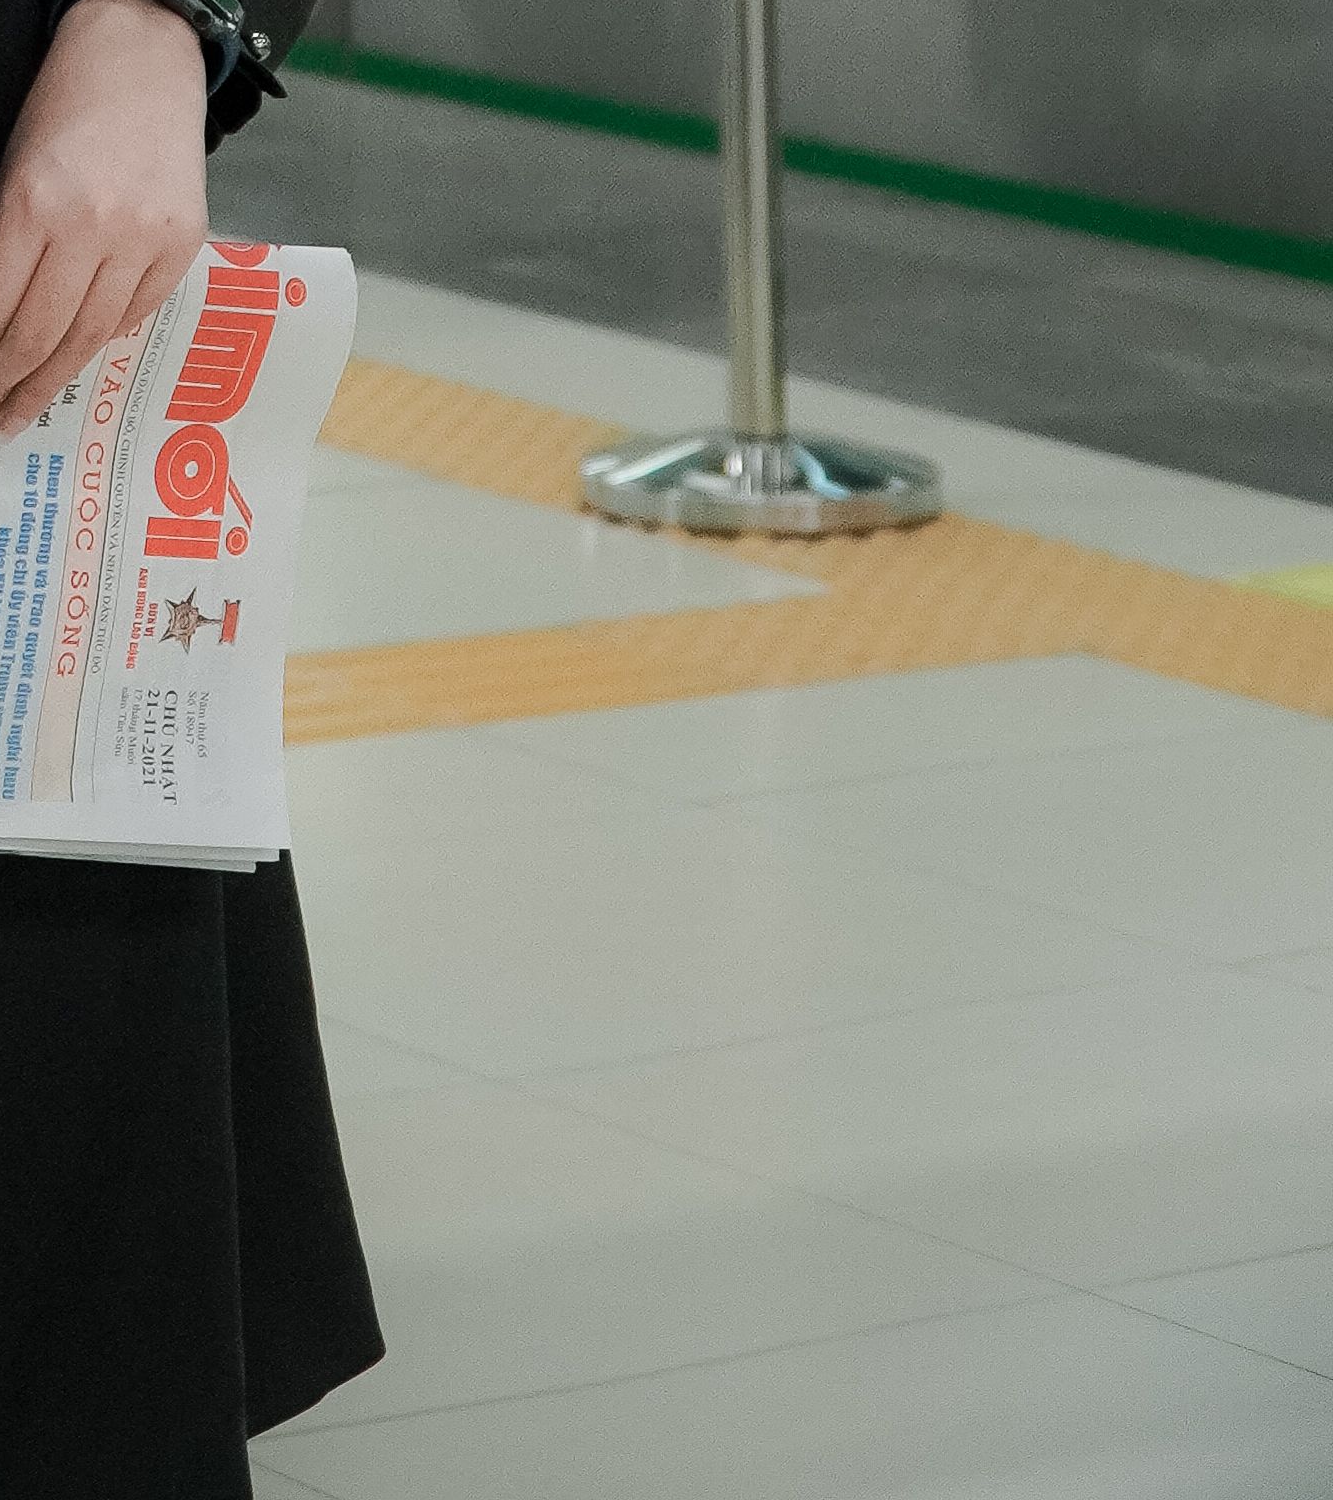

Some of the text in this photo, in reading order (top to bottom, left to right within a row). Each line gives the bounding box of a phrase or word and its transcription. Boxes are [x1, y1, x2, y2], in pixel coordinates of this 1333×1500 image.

[26, 453, 41, 485] cho
[47, 454, 64, 498] Khen
[23, 490, 38, 508] 10
[57, 355, 131, 676] VÀO CUỘC SỐNG
[29, 594, 46, 627] trao
[135, 690, 143, 700] 17
[143, 690, 160, 784] 21-11-2021
[198, 745, 207, 757] 65
[159, 745, 177, 805] NHẬT
